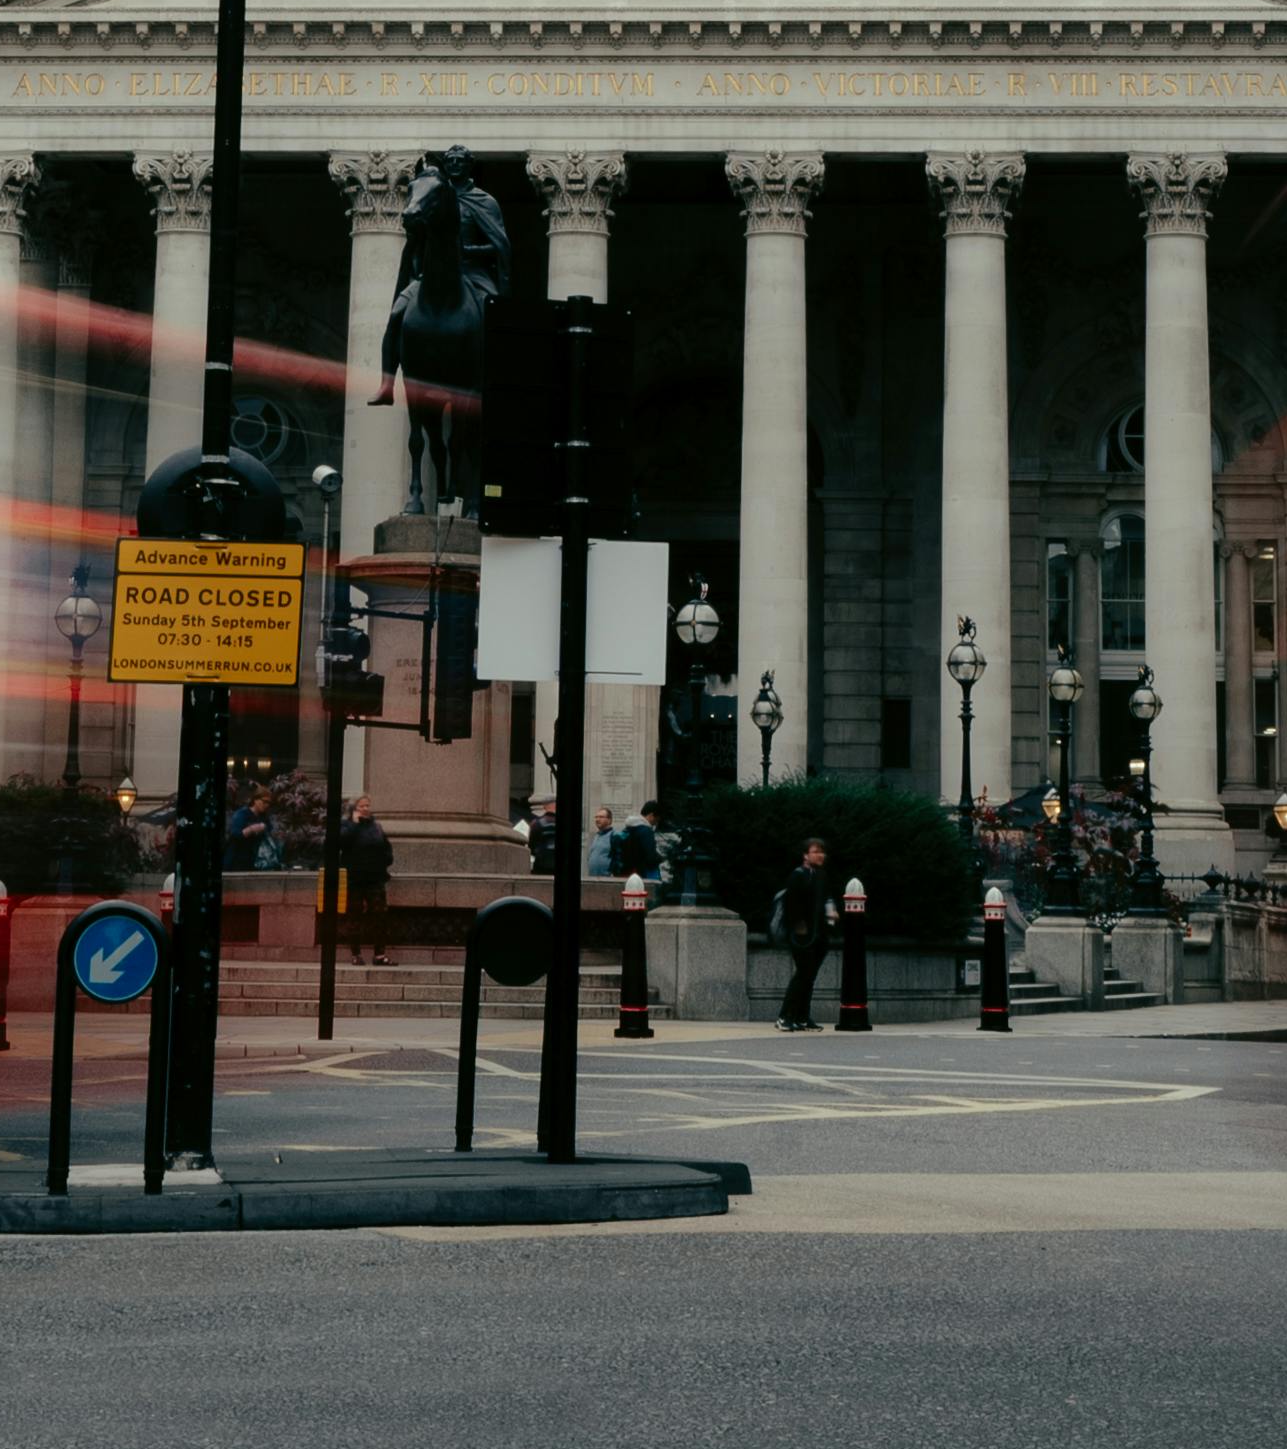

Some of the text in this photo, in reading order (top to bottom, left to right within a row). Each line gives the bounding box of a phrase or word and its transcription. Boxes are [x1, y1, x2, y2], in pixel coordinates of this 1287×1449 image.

[12, 72, 106, 97] ANNO
[380, 72, 400, 97] R
[418, 72, 469, 97] XIII
[486, 72, 655, 97] CONDITVM
[696, 72, 791, 97] ANNO
[812, 72, 986, 97] VICTORIAE
[1006, 72, 1028, 97] R
[1048, 72, 1100, 97] VIII
[135, 550, 287, 570] Advance Warning
[126, 587, 293, 608] ROAD CLOSED
[123, 613, 291, 630] Sunday 5th September
[158, 633, 202, 646] 07:30
[216, 635, 253, 648] 14:15
[113, 658, 293, 673] LONDONSUMMERRUN.CO.UK
